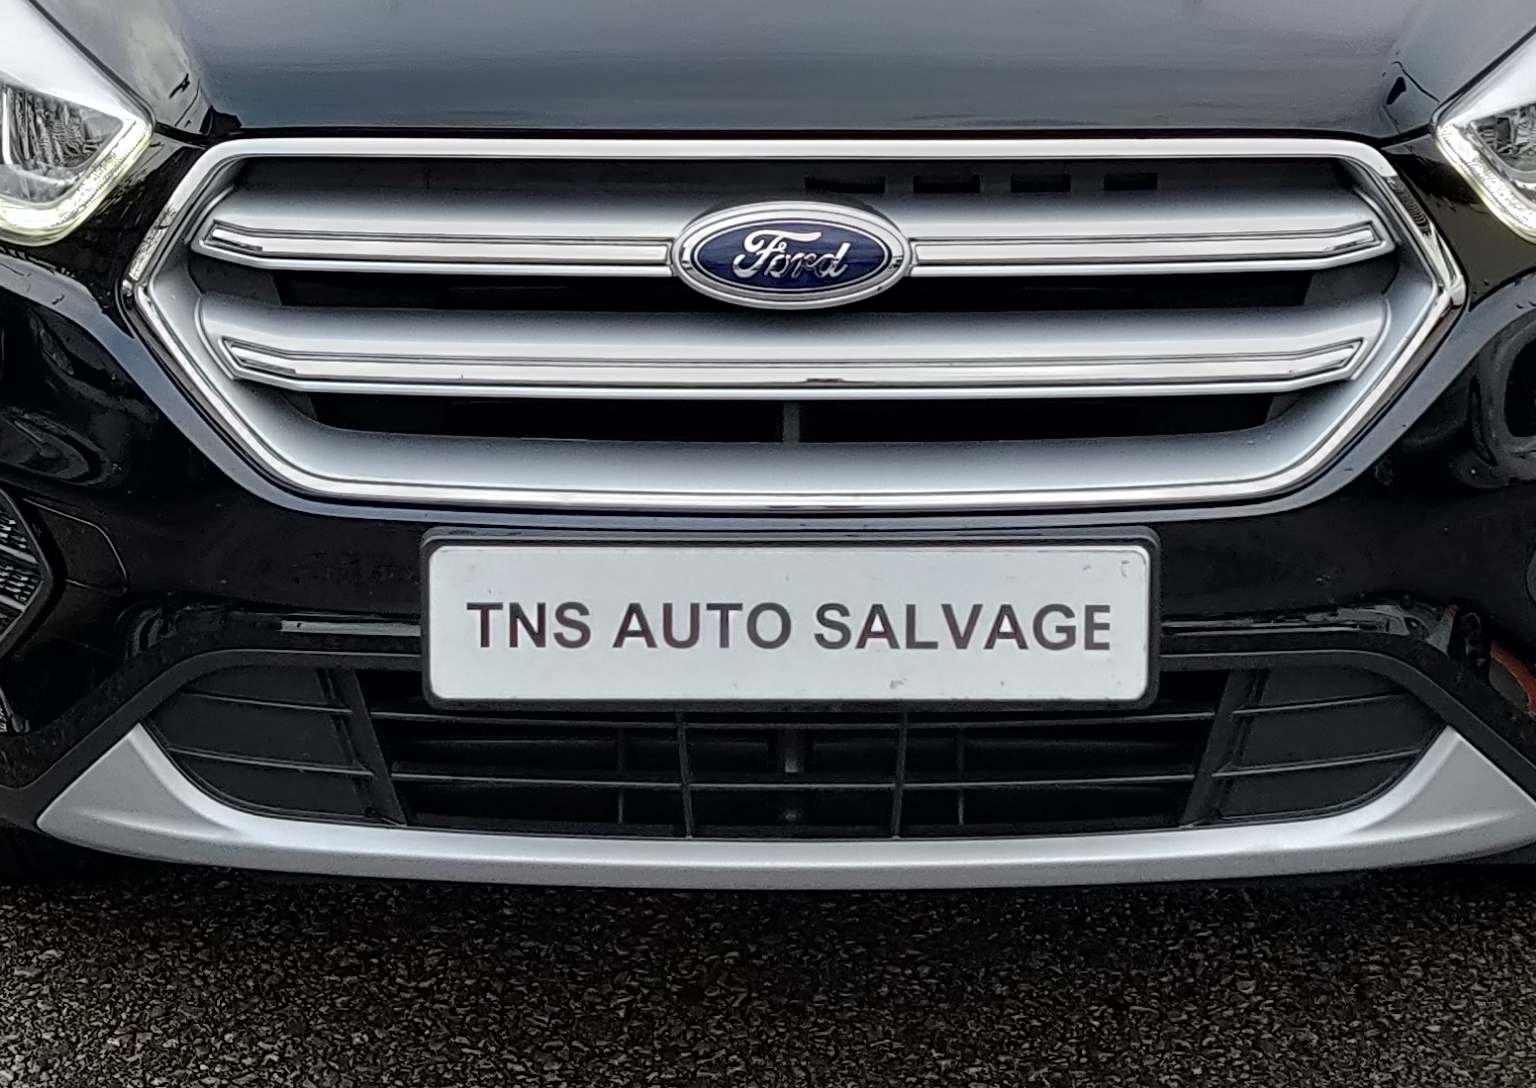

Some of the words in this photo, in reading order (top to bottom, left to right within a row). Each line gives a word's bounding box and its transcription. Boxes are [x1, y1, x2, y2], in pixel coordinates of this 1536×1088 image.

[731, 228, 852, 279] Ford
[466, 601, 591, 648] TNS
[612, 601, 792, 650] AUTO
[813, 602, 1112, 651] SALVAGE
